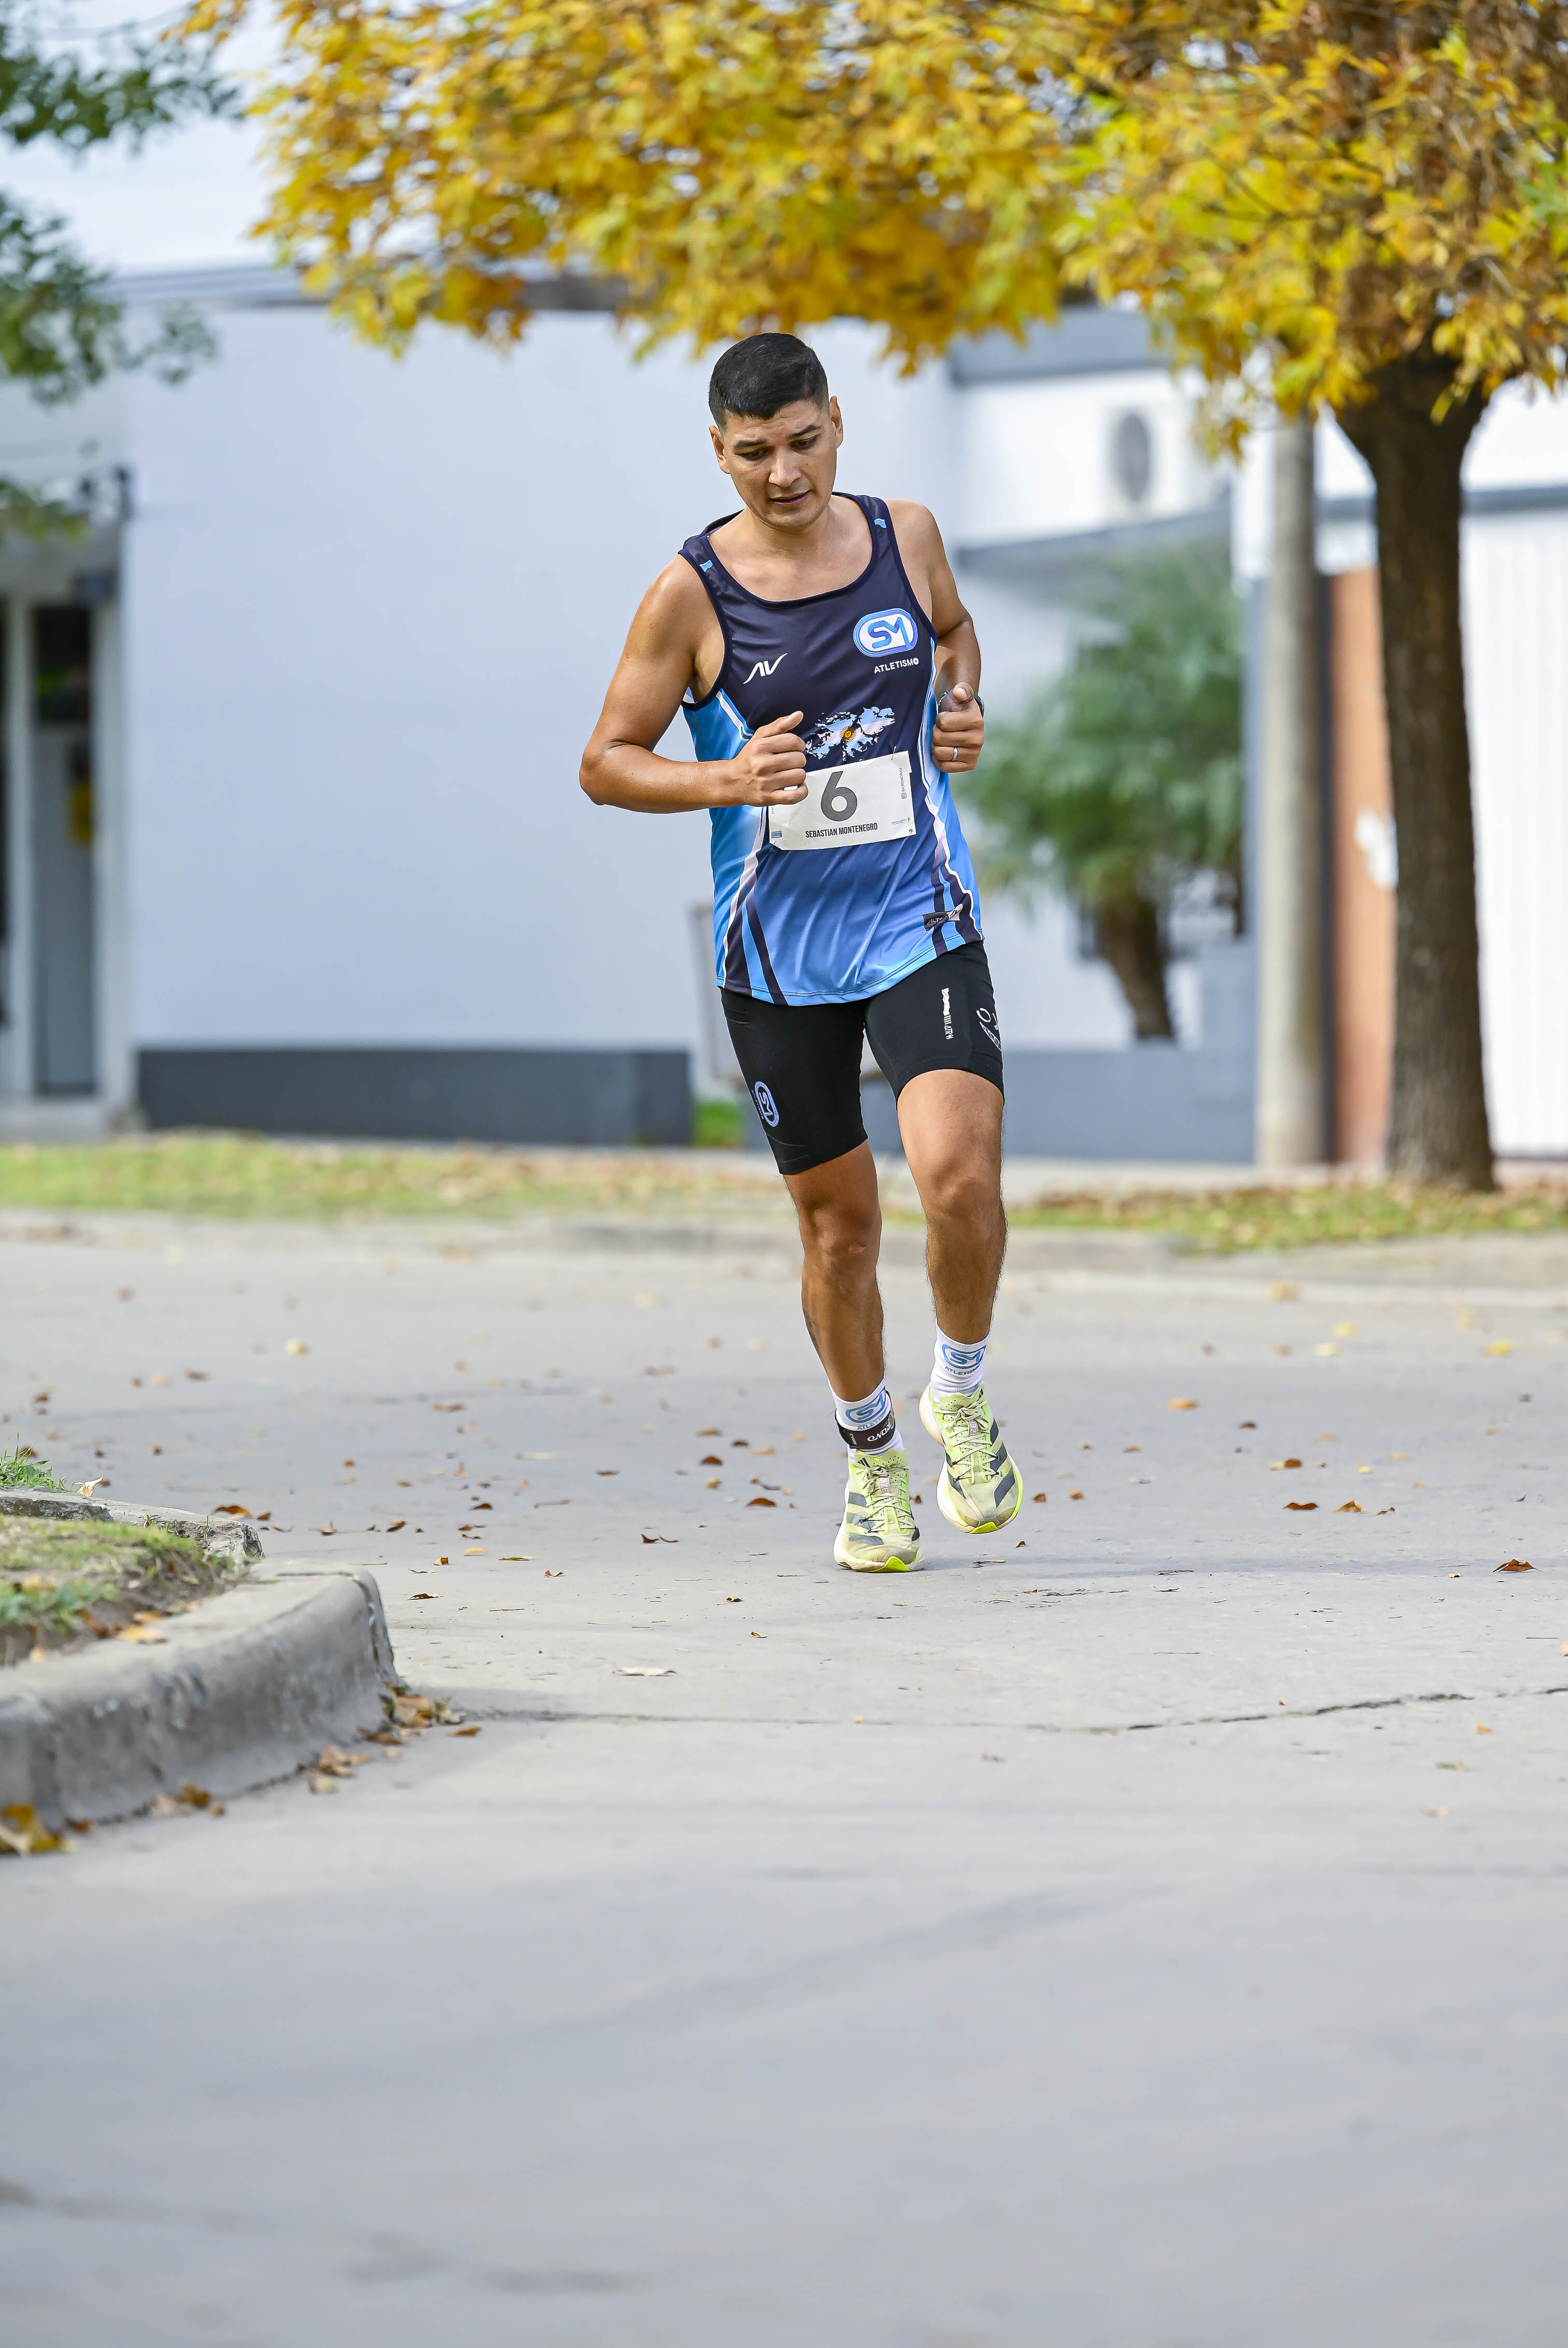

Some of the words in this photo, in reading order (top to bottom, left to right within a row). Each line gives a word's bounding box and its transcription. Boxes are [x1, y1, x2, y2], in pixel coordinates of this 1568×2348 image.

[867, 617, 912, 649] SM
[874, 657, 919, 674] ATLETISMO
[820, 771, 858, 822] 6
[805, 828, 837, 838] SEBASTIAN
[838, 822, 878, 835] MONTENEGRO
